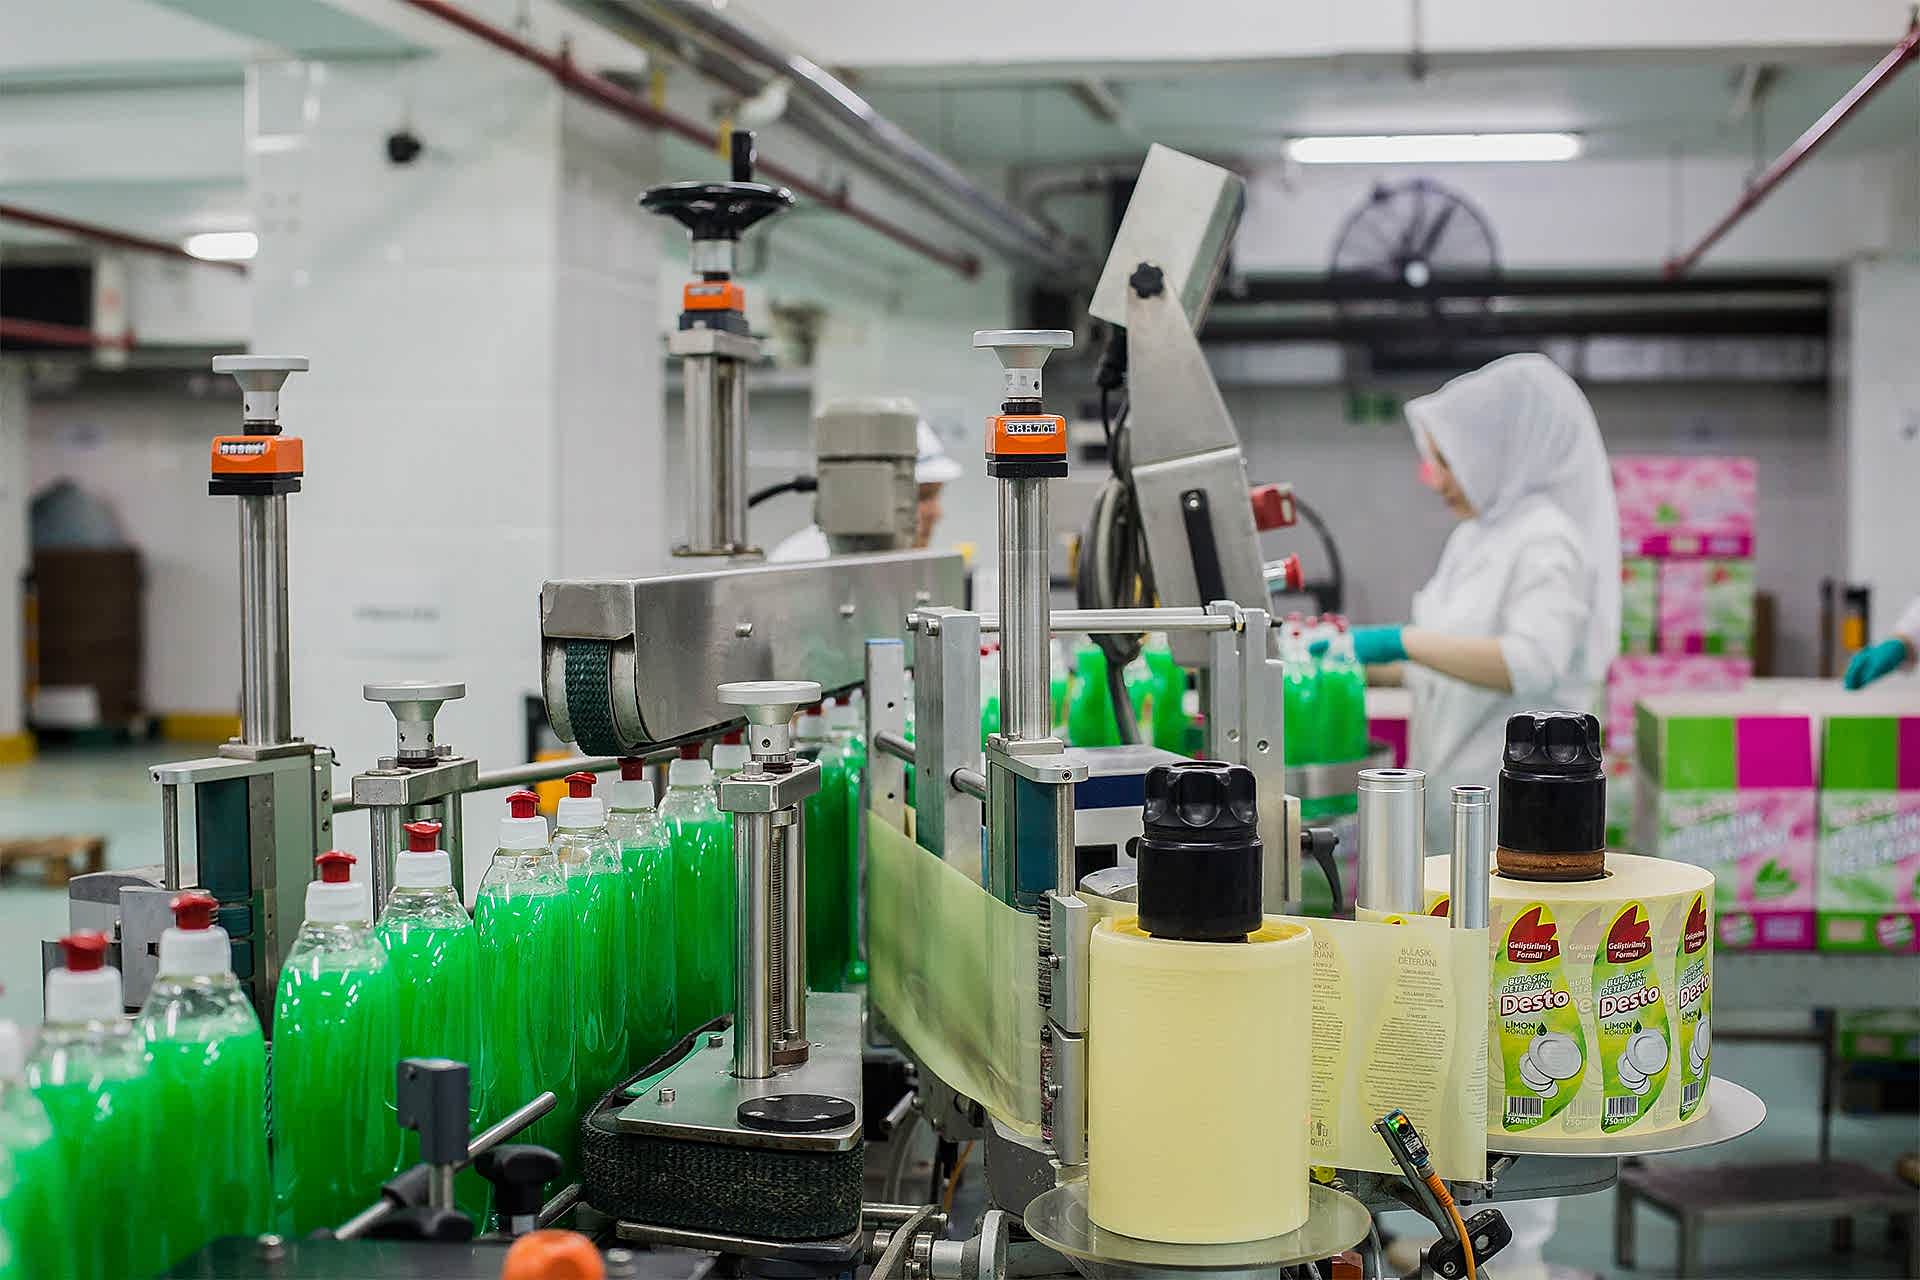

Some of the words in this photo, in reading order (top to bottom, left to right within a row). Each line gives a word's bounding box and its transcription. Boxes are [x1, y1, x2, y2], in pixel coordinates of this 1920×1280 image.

[1509, 941, 1552, 952] Geliştirilmiş
[1608, 939, 1646, 951] Geliştirilmiş
[1516, 951, 1543, 960] Formül
[1615, 950, 1639, 959] Formül
[1507, 973, 1549, 986] BULAŞIK
[1607, 969, 1645, 987] BULAŞIK
[1502, 980, 1552, 994] DETERJANI
[1601, 978, 1646, 996] DETERJANI
[1680, 973, 1710, 1009] Desto
[1501, 988, 1570, 1016] Desto
[1600, 986, 1660, 1019] Desto
[1505, 1020, 1536, 1029] LİMON
[1604, 1021, 1633, 1031] LİMON
